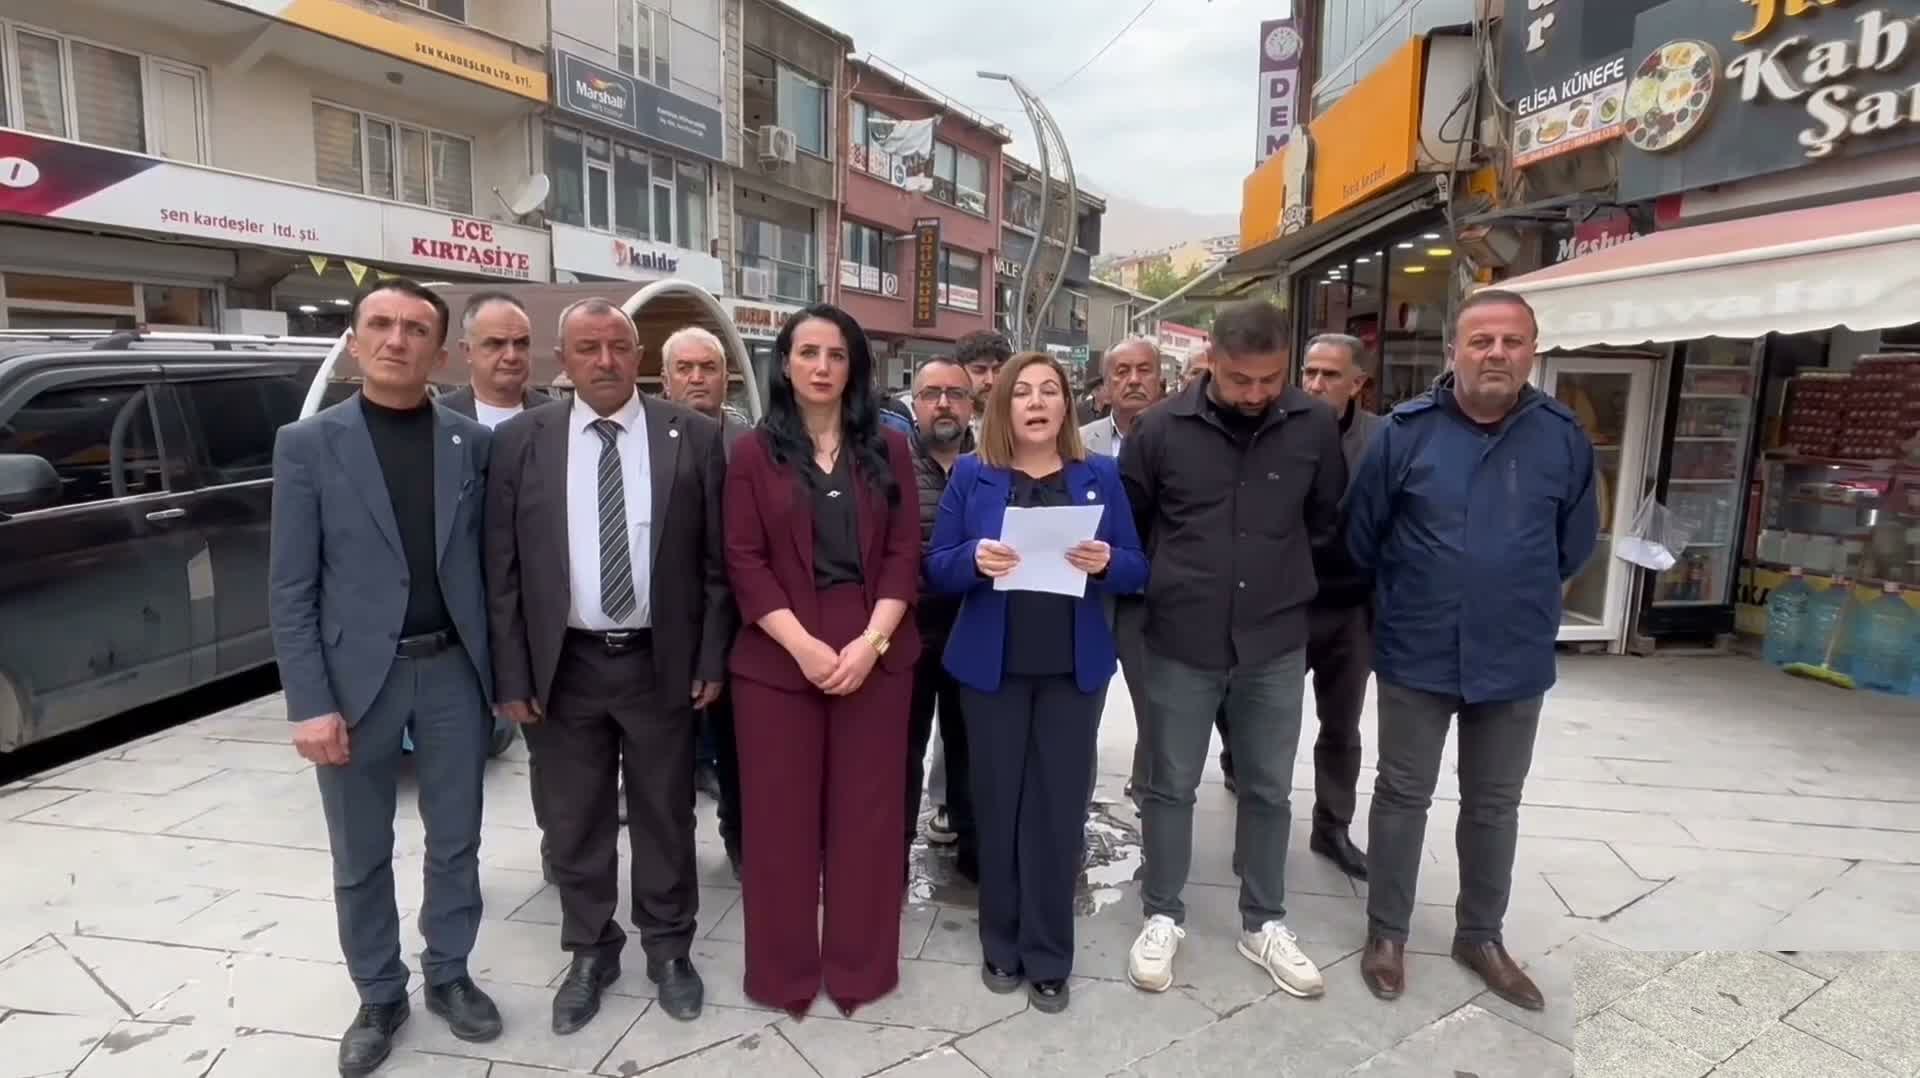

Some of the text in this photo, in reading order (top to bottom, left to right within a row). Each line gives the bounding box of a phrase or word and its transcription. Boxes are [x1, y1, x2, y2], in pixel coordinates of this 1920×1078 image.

[576, 80, 625, 109] Marshall
[1518, 56, 1625, 116] ELİSA KÜNEFE
[1266, 77, 1290, 156] DEM
[160, 208, 320, 244] şen kardeşler ltd. şti.
[451, 219, 494, 243] ECE
[412, 237, 530, 271] KIRTASİYE
